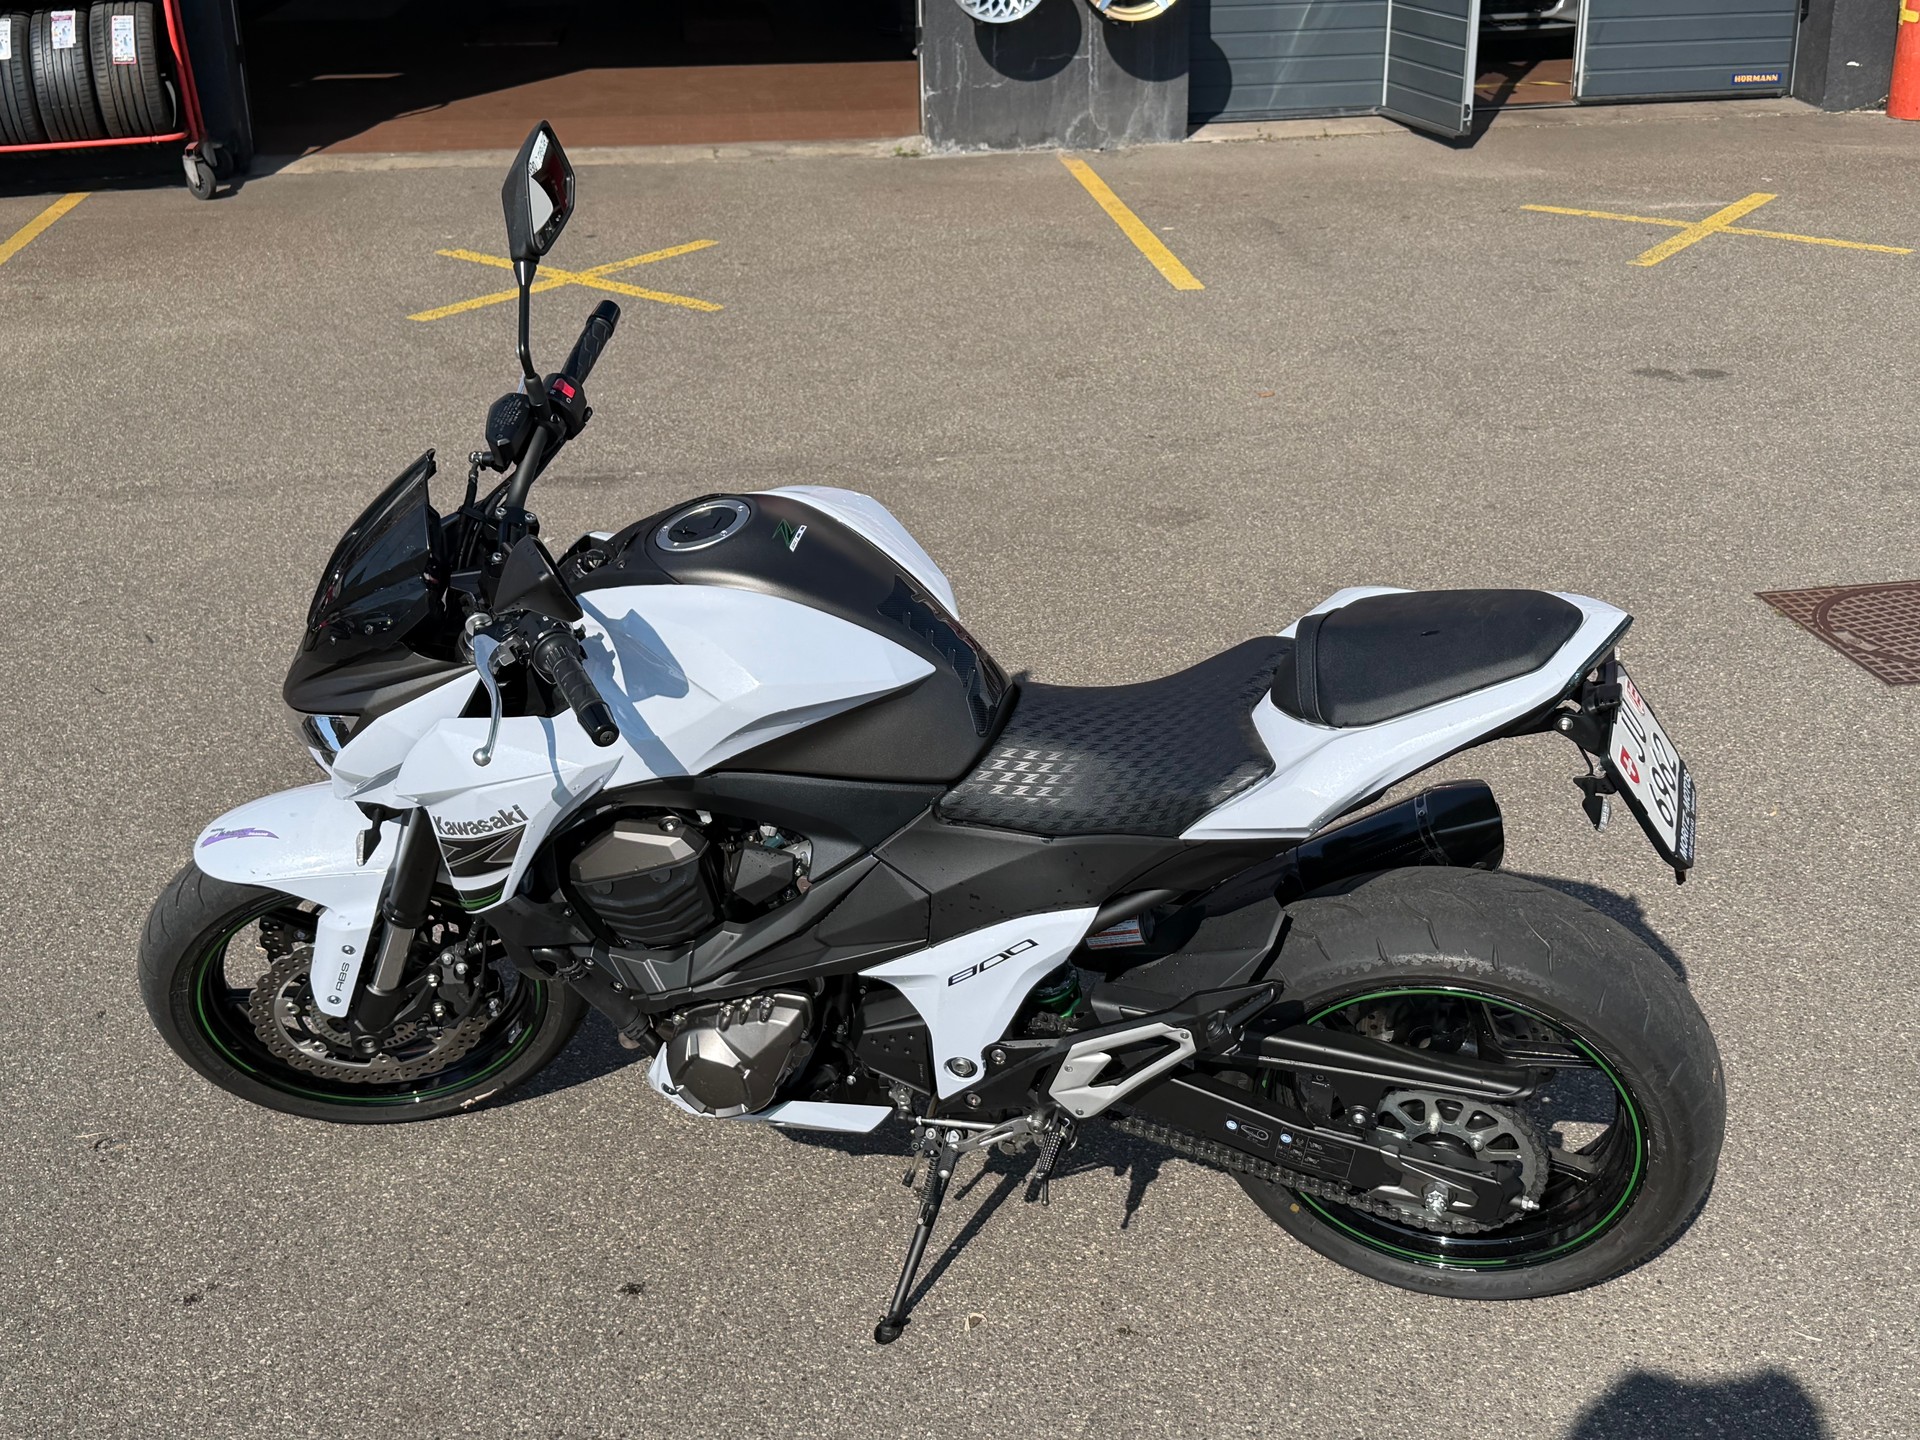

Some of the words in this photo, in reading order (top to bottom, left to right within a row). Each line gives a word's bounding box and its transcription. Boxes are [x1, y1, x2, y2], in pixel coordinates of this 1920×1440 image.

[1621, 700, 1646, 763] JU
[1649, 732, 1676, 828] 6962
[432, 804, 529, 835] Kawasaki
[335, 961, 350, 992] ABS
[948, 938, 1039, 987] 800
